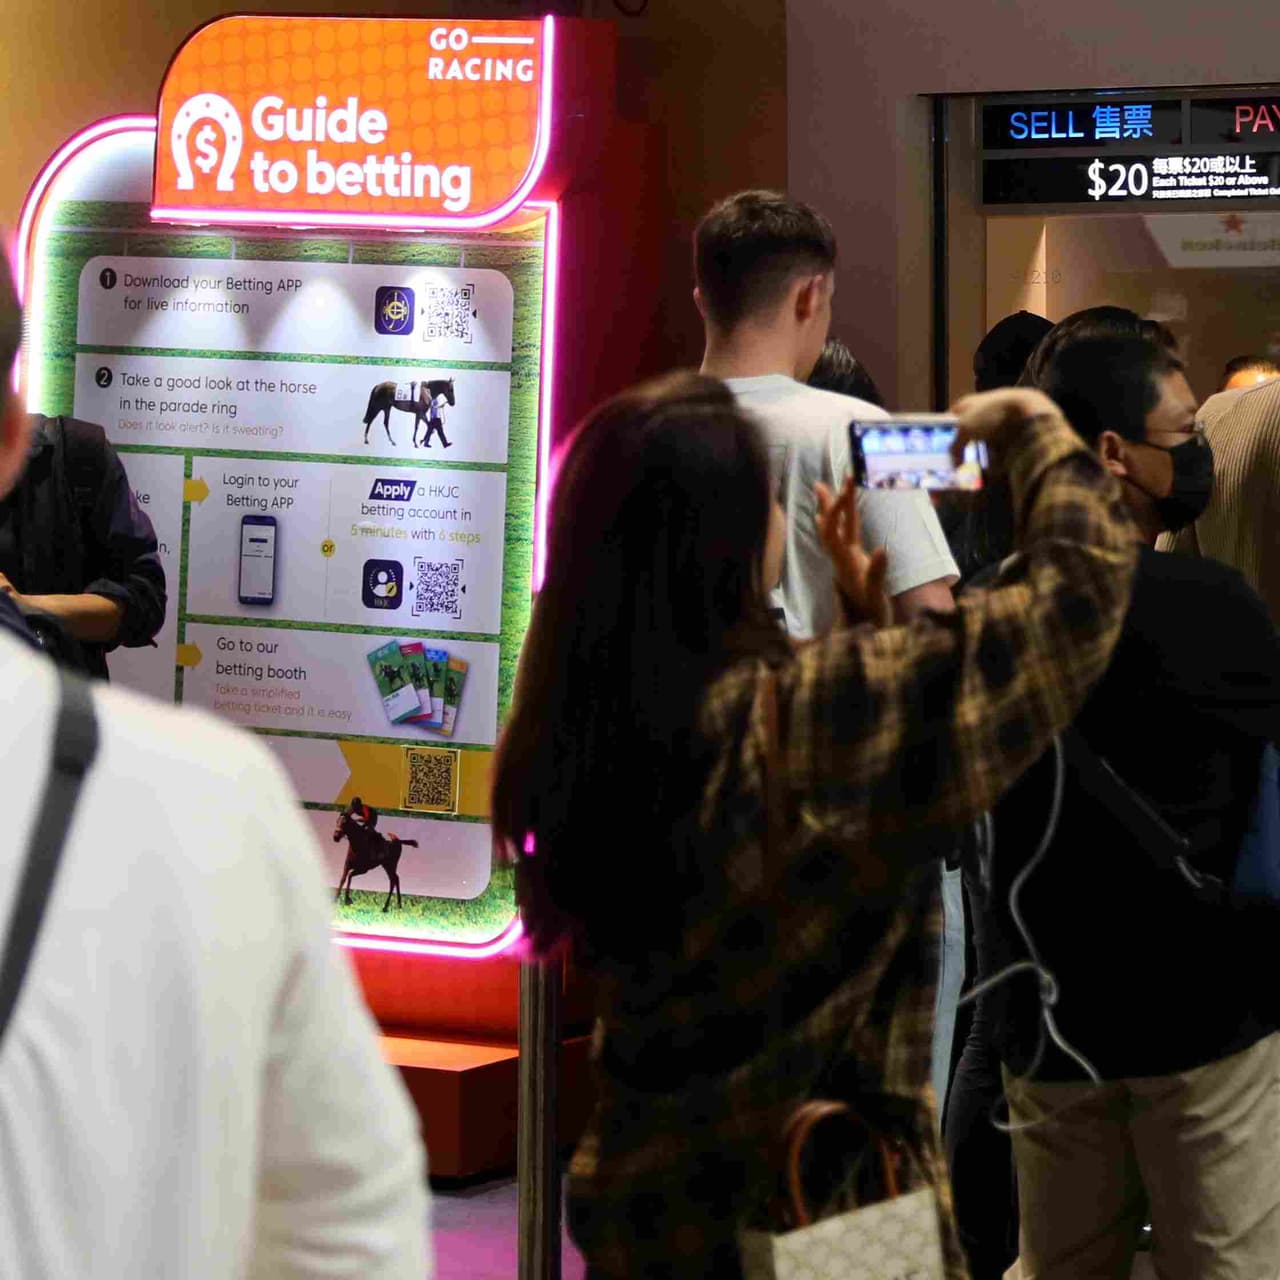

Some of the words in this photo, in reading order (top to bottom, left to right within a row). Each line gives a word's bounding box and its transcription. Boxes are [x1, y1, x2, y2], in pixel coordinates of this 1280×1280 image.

[430, 27, 469, 51] GO
[428, 57, 533, 82] RACING
[251, 95, 388, 144] Guide
[1010, 111, 1084, 139] SELL
[1092, 105, 1153, 139] 售票
[250, 151, 298, 194] to
[306, 149, 472, 213] betting
[1088, 158, 1148, 201] $20
[123, 273, 191, 291] Download
[192, 275, 223, 294] your
[226, 277, 273, 295] Betting
[276, 279, 302, 292] APP
[124, 296, 142, 310] for
[145, 296, 170, 313] live
[172, 298, 250, 315] information
[119, 372, 150, 387] Take
[154, 377, 162, 387] a
[166, 376, 201, 392] good
[205, 376, 232, 391] look
[236, 379, 250, 391] at
[254, 378, 276, 392] the
[280, 379, 317, 394] horse
[120, 396, 131, 410] in
[135, 397, 156, 411] the
[159, 400, 208, 416] parade
[212, 401, 237, 419] ring
[223, 473, 254, 489] Login
[258, 476, 270, 487] to
[273, 478, 299, 491] your
[374, 482, 411, 499] Apply
[226, 494, 268, 511] Betting
[271, 496, 294, 509] APP
[216, 660, 263, 681] betting
[267, 664, 306, 680] booth
